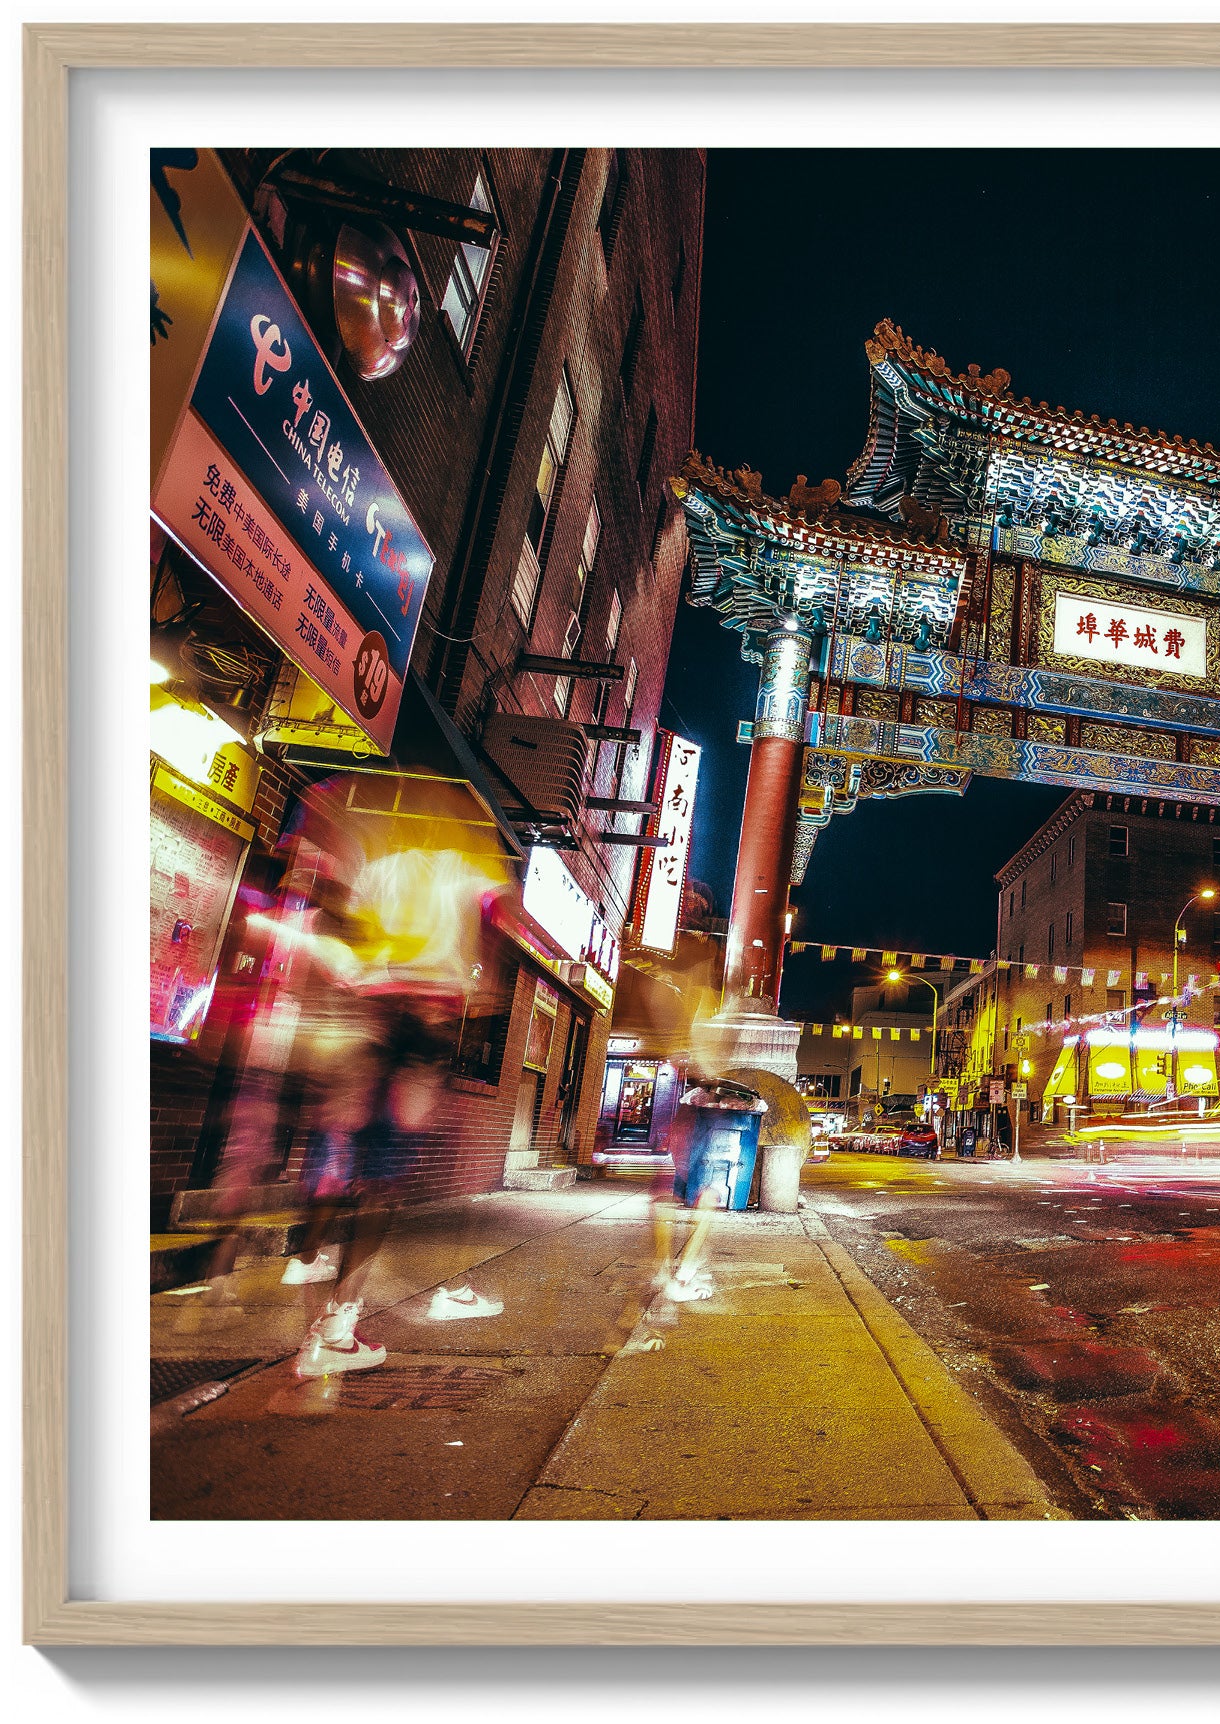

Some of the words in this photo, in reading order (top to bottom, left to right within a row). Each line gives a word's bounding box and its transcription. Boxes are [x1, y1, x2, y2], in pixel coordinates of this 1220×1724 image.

[282, 419, 312, 470] CHINA
[311, 463, 350, 526] TELECOM
[292, 379, 360, 507] 中国电信
[191, 495, 285, 613] 无限美国本地通话
[203, 463, 292, 582] 免费中美国际长途
[296, 488, 364, 588] 美国手机卡
[295, 612, 341, 676] 无限量短信
[302, 583, 348, 650] 无限量流量
[1076, 612, 1186, 660] 埠華城費
[359, 649, 387, 703] $19
